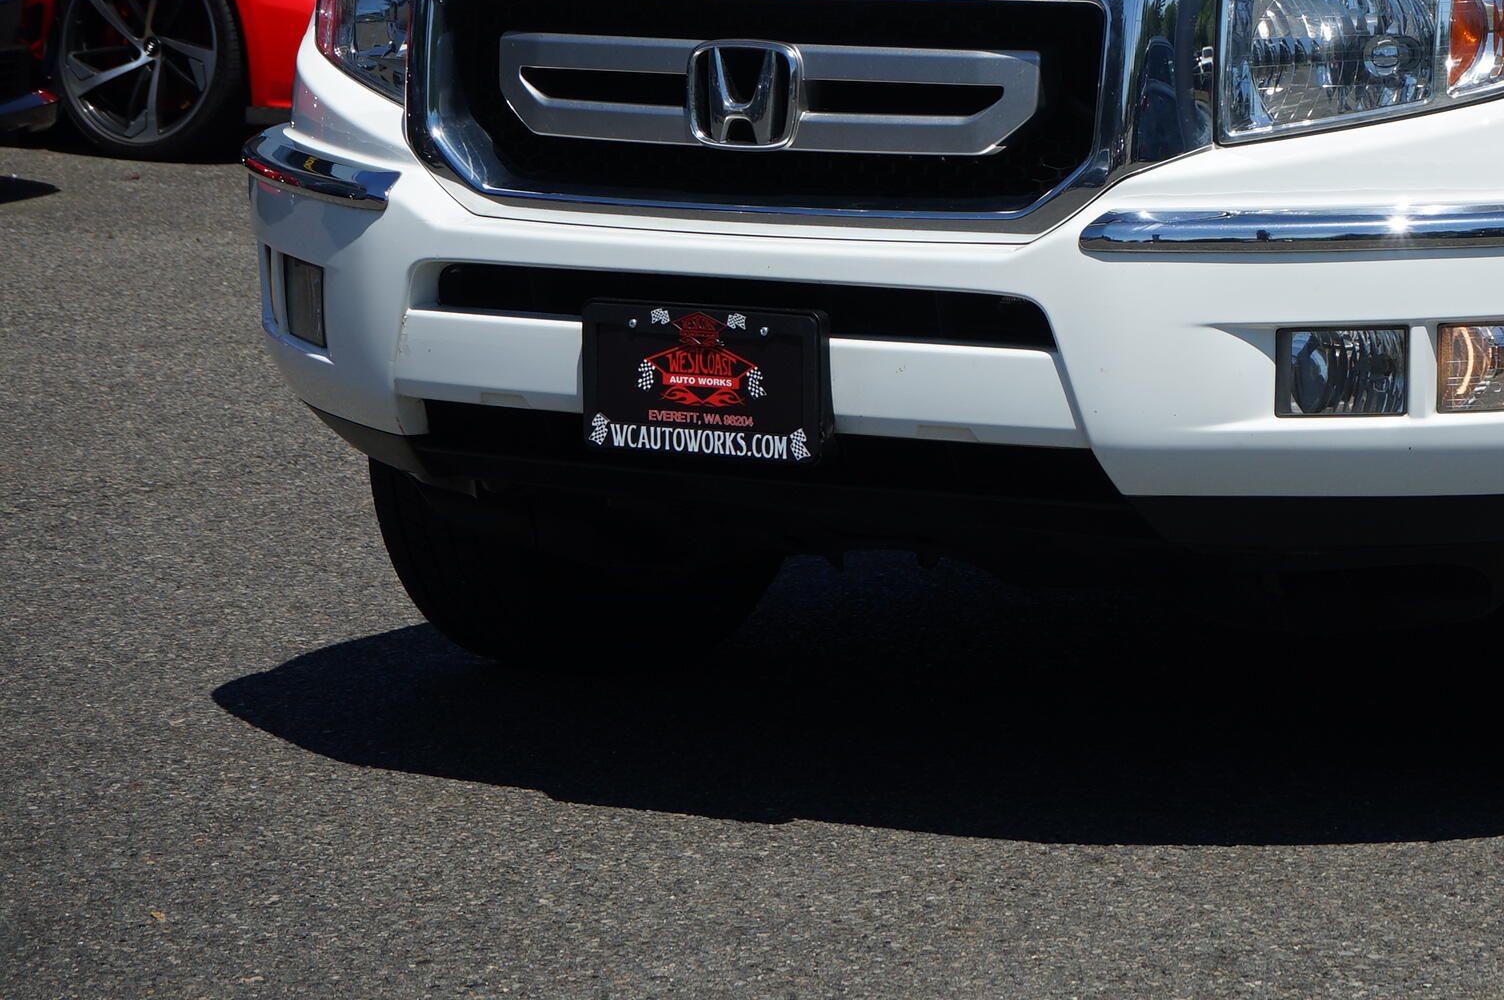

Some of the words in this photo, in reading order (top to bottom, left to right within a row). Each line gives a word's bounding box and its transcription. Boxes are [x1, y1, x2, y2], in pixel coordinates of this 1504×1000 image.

[669, 375, 696, 385] AUTO
[698, 377, 733, 387] WORKS
[648, 409, 702, 425] EVERETT,
[704, 412, 722, 425] WA
[610, 423, 788, 460] WCAUTOWORKS.COM
